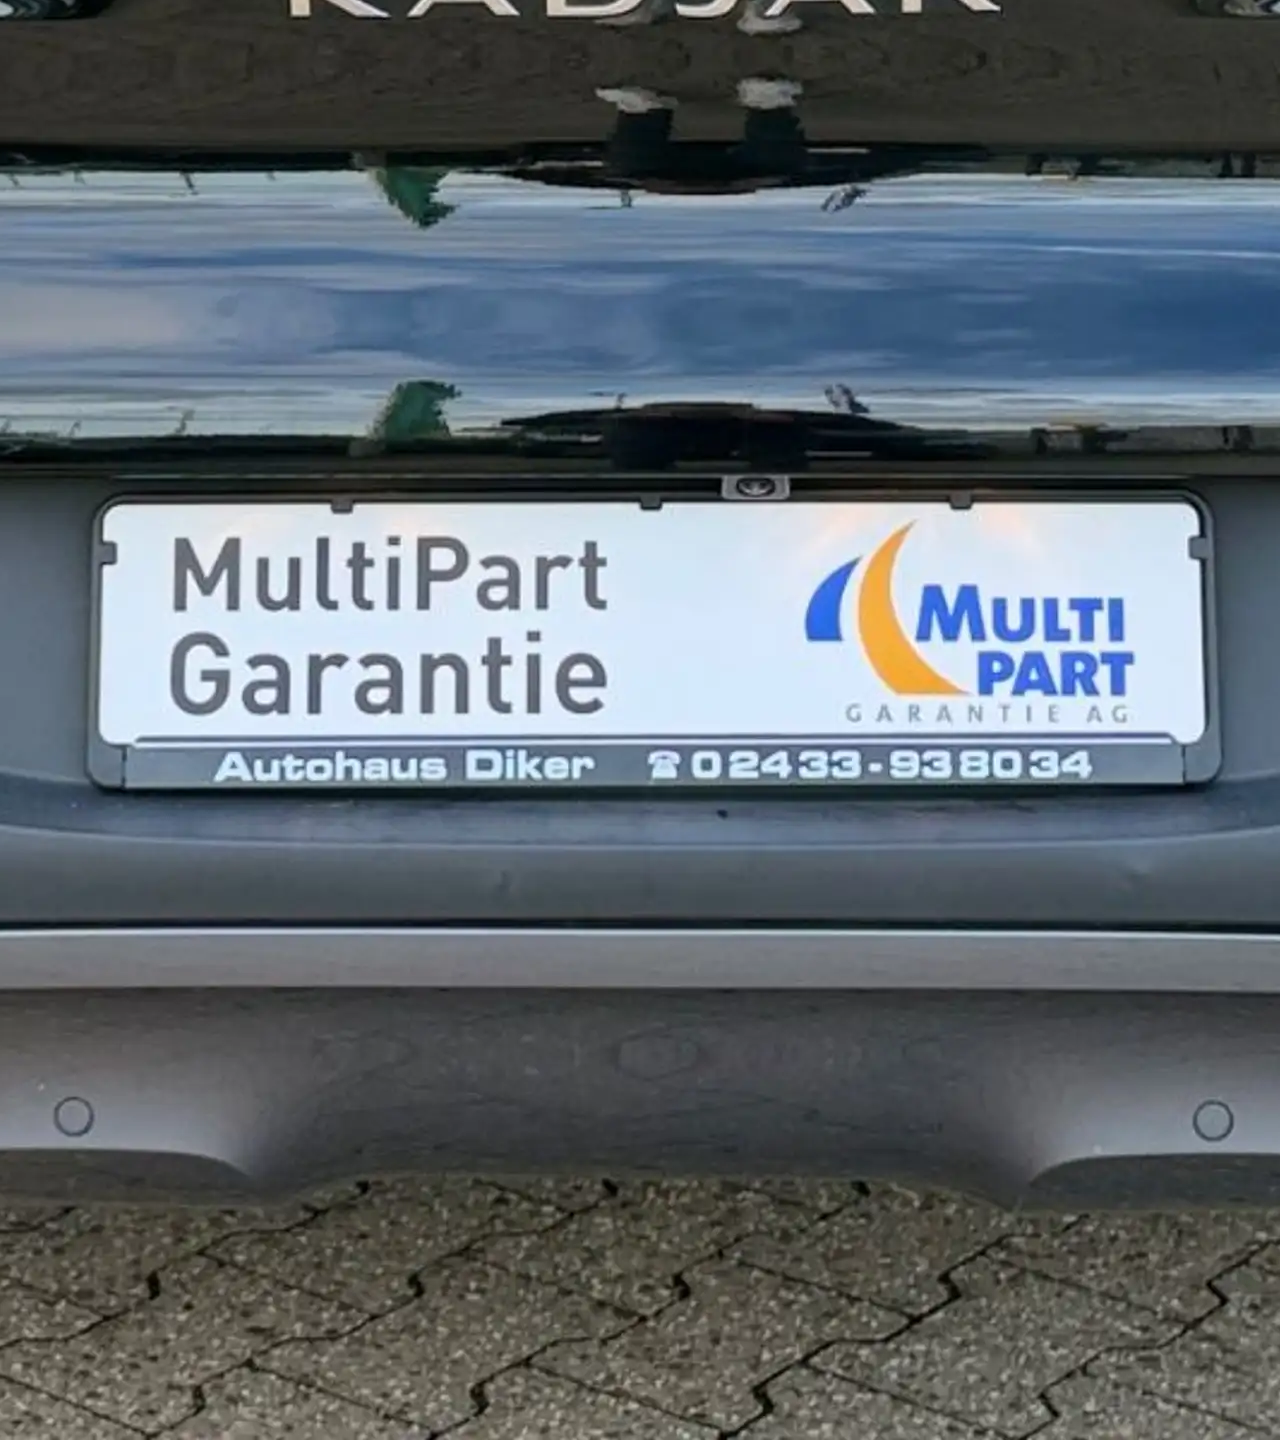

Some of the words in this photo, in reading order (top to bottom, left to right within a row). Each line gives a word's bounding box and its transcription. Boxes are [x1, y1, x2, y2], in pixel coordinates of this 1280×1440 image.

[173, 535, 608, 612] MultiPart
[914, 583, 1125, 642] MULTI
[170, 630, 608, 716] Garantie
[976, 649, 1136, 697] PART
[845, 703, 1060, 724] GARANTIE
[1086, 703, 1130, 724] AG
[214, 750, 447, 782] Autohaus
[465, 749, 596, 781] Diker
